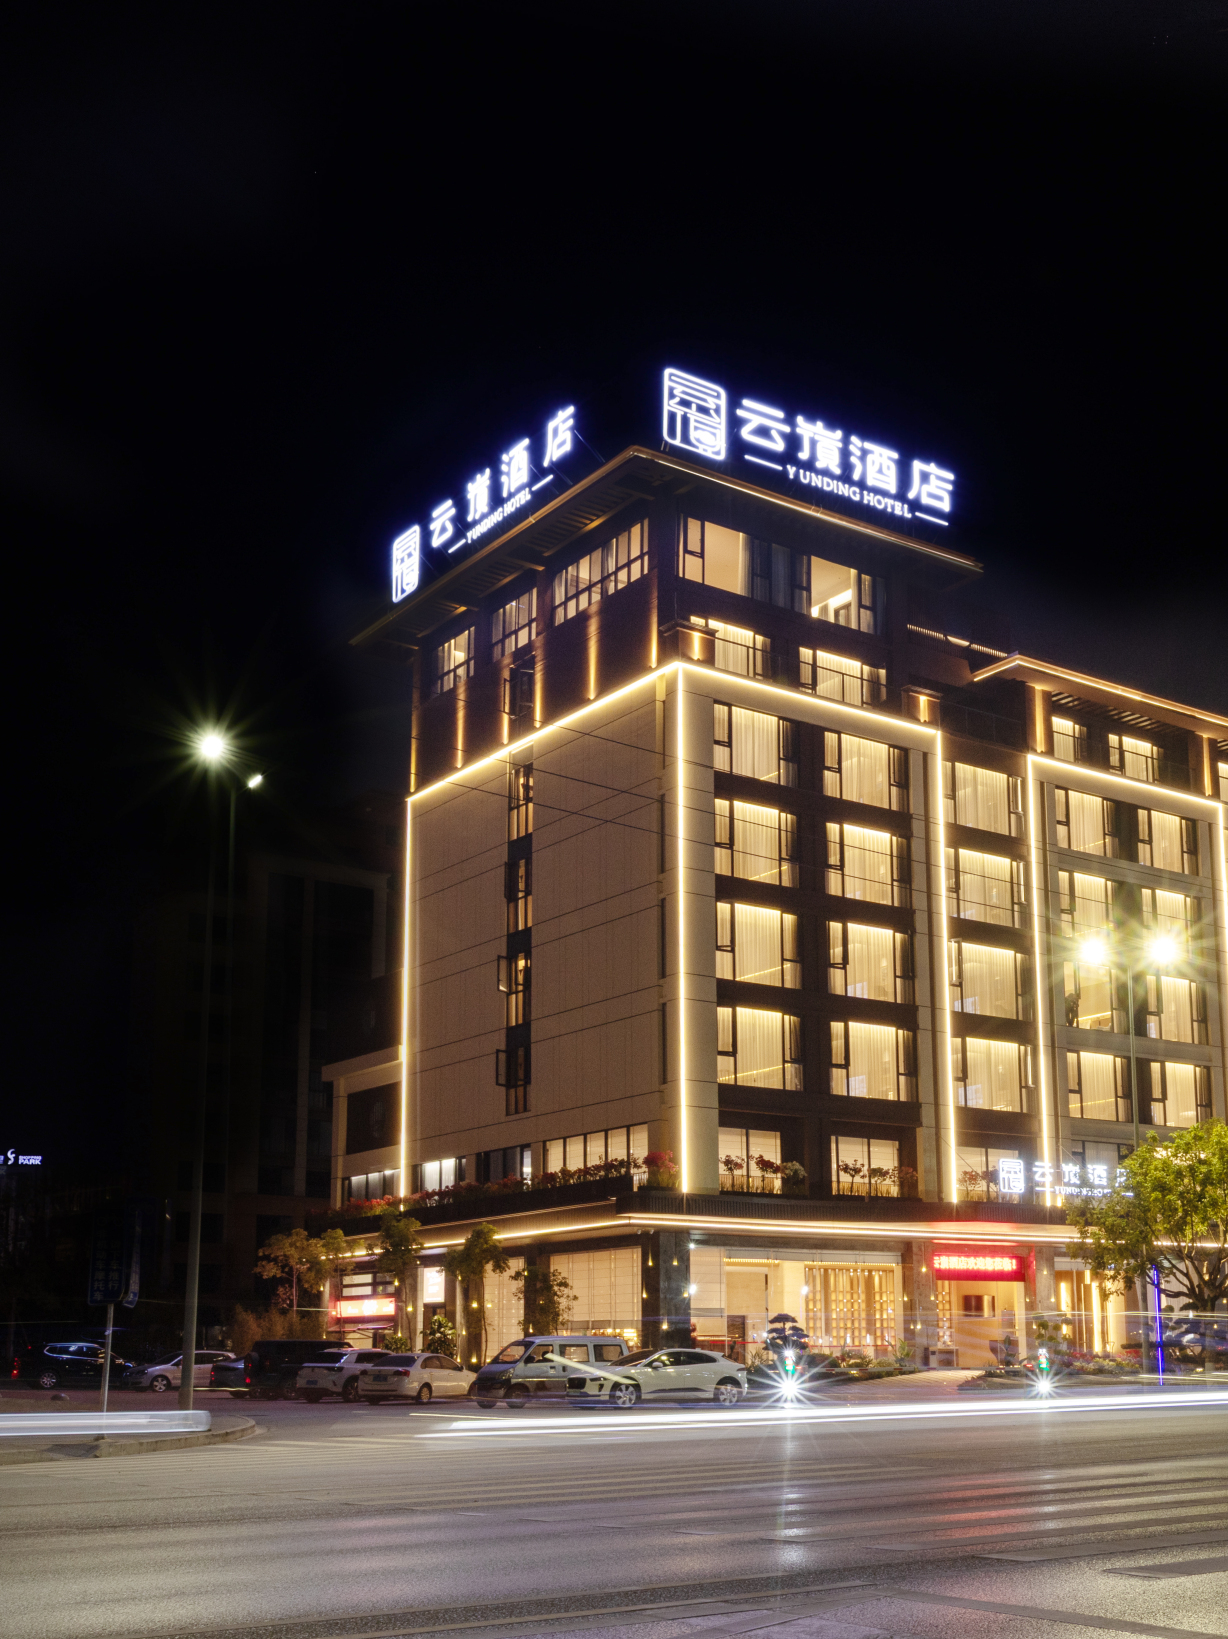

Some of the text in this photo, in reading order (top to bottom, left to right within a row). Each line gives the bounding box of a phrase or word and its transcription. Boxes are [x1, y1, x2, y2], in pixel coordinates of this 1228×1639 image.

[466, 487, 531, 544] YUNDING HOTEL
[786, 464, 912, 518] YUNDING HOTEL
